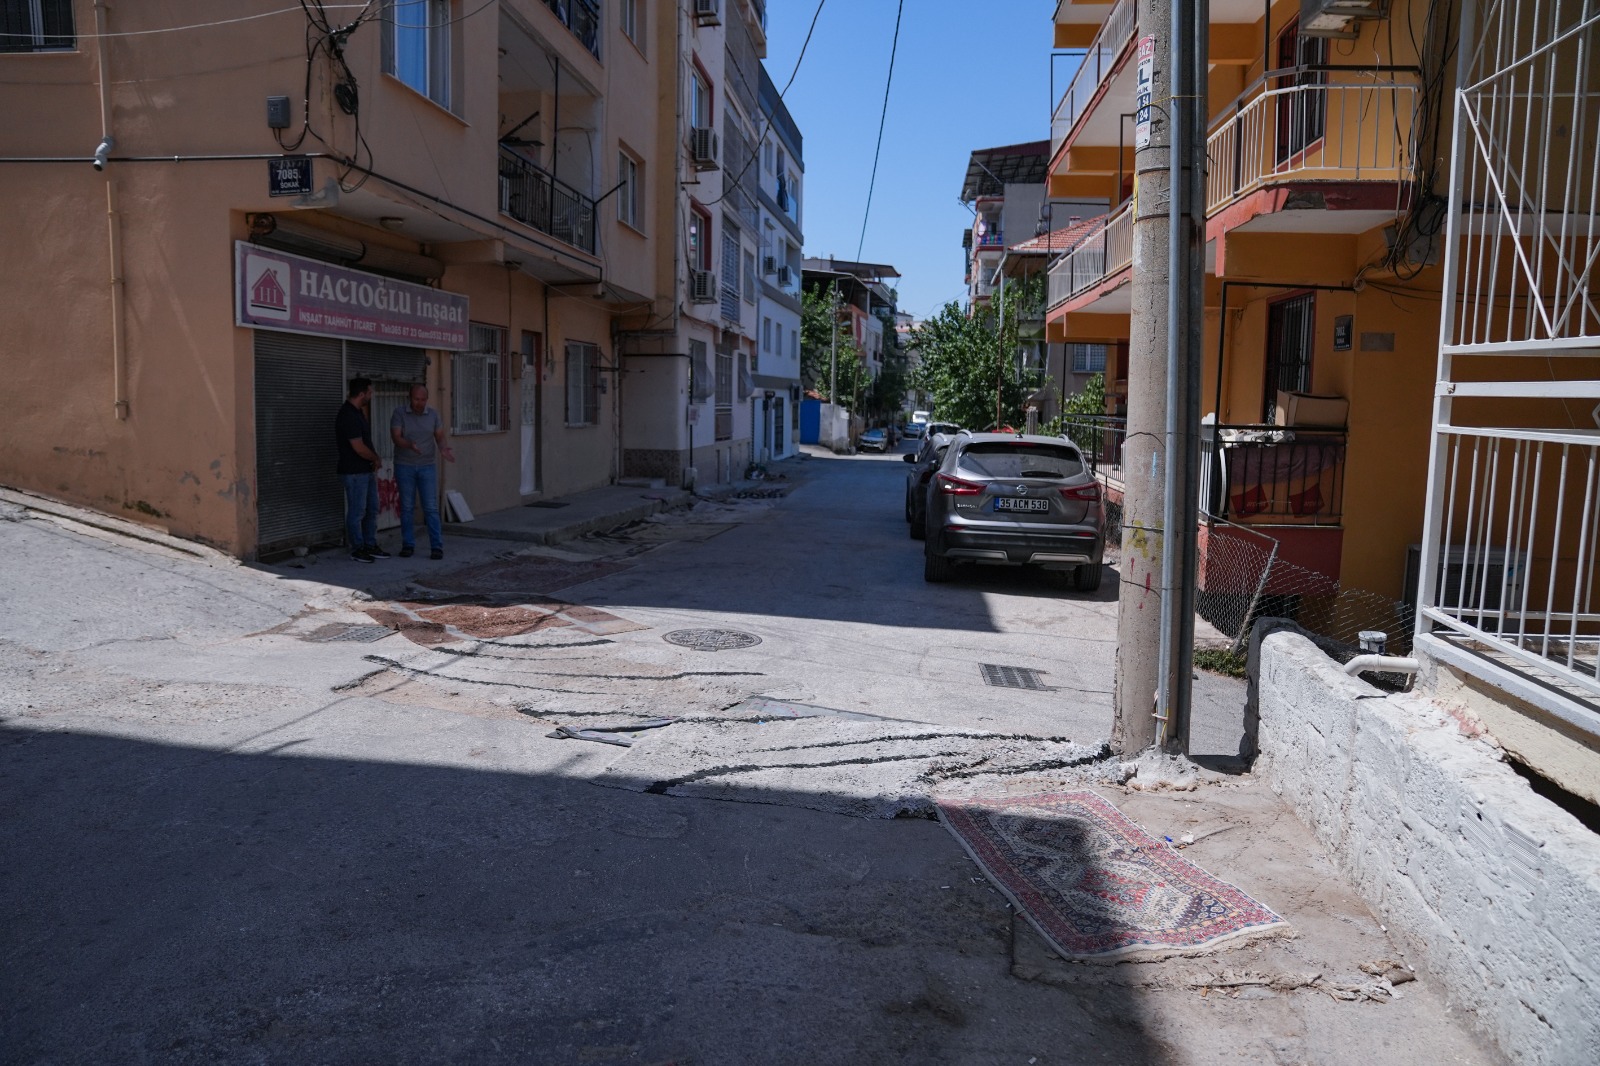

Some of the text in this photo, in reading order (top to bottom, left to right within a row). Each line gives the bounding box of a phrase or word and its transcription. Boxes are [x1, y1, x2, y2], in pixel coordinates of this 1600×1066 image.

[276, 169, 301, 180] 7085.
[299, 269, 463, 326] HACIOĞLU inşaat
[298, 308, 323, 326] İNŞAAT
[324, 315, 352, 329] TAAHHÜT
[353, 317, 377, 332] TİCARET
[1000, 499, 1048, 510] 35 ACM 538
